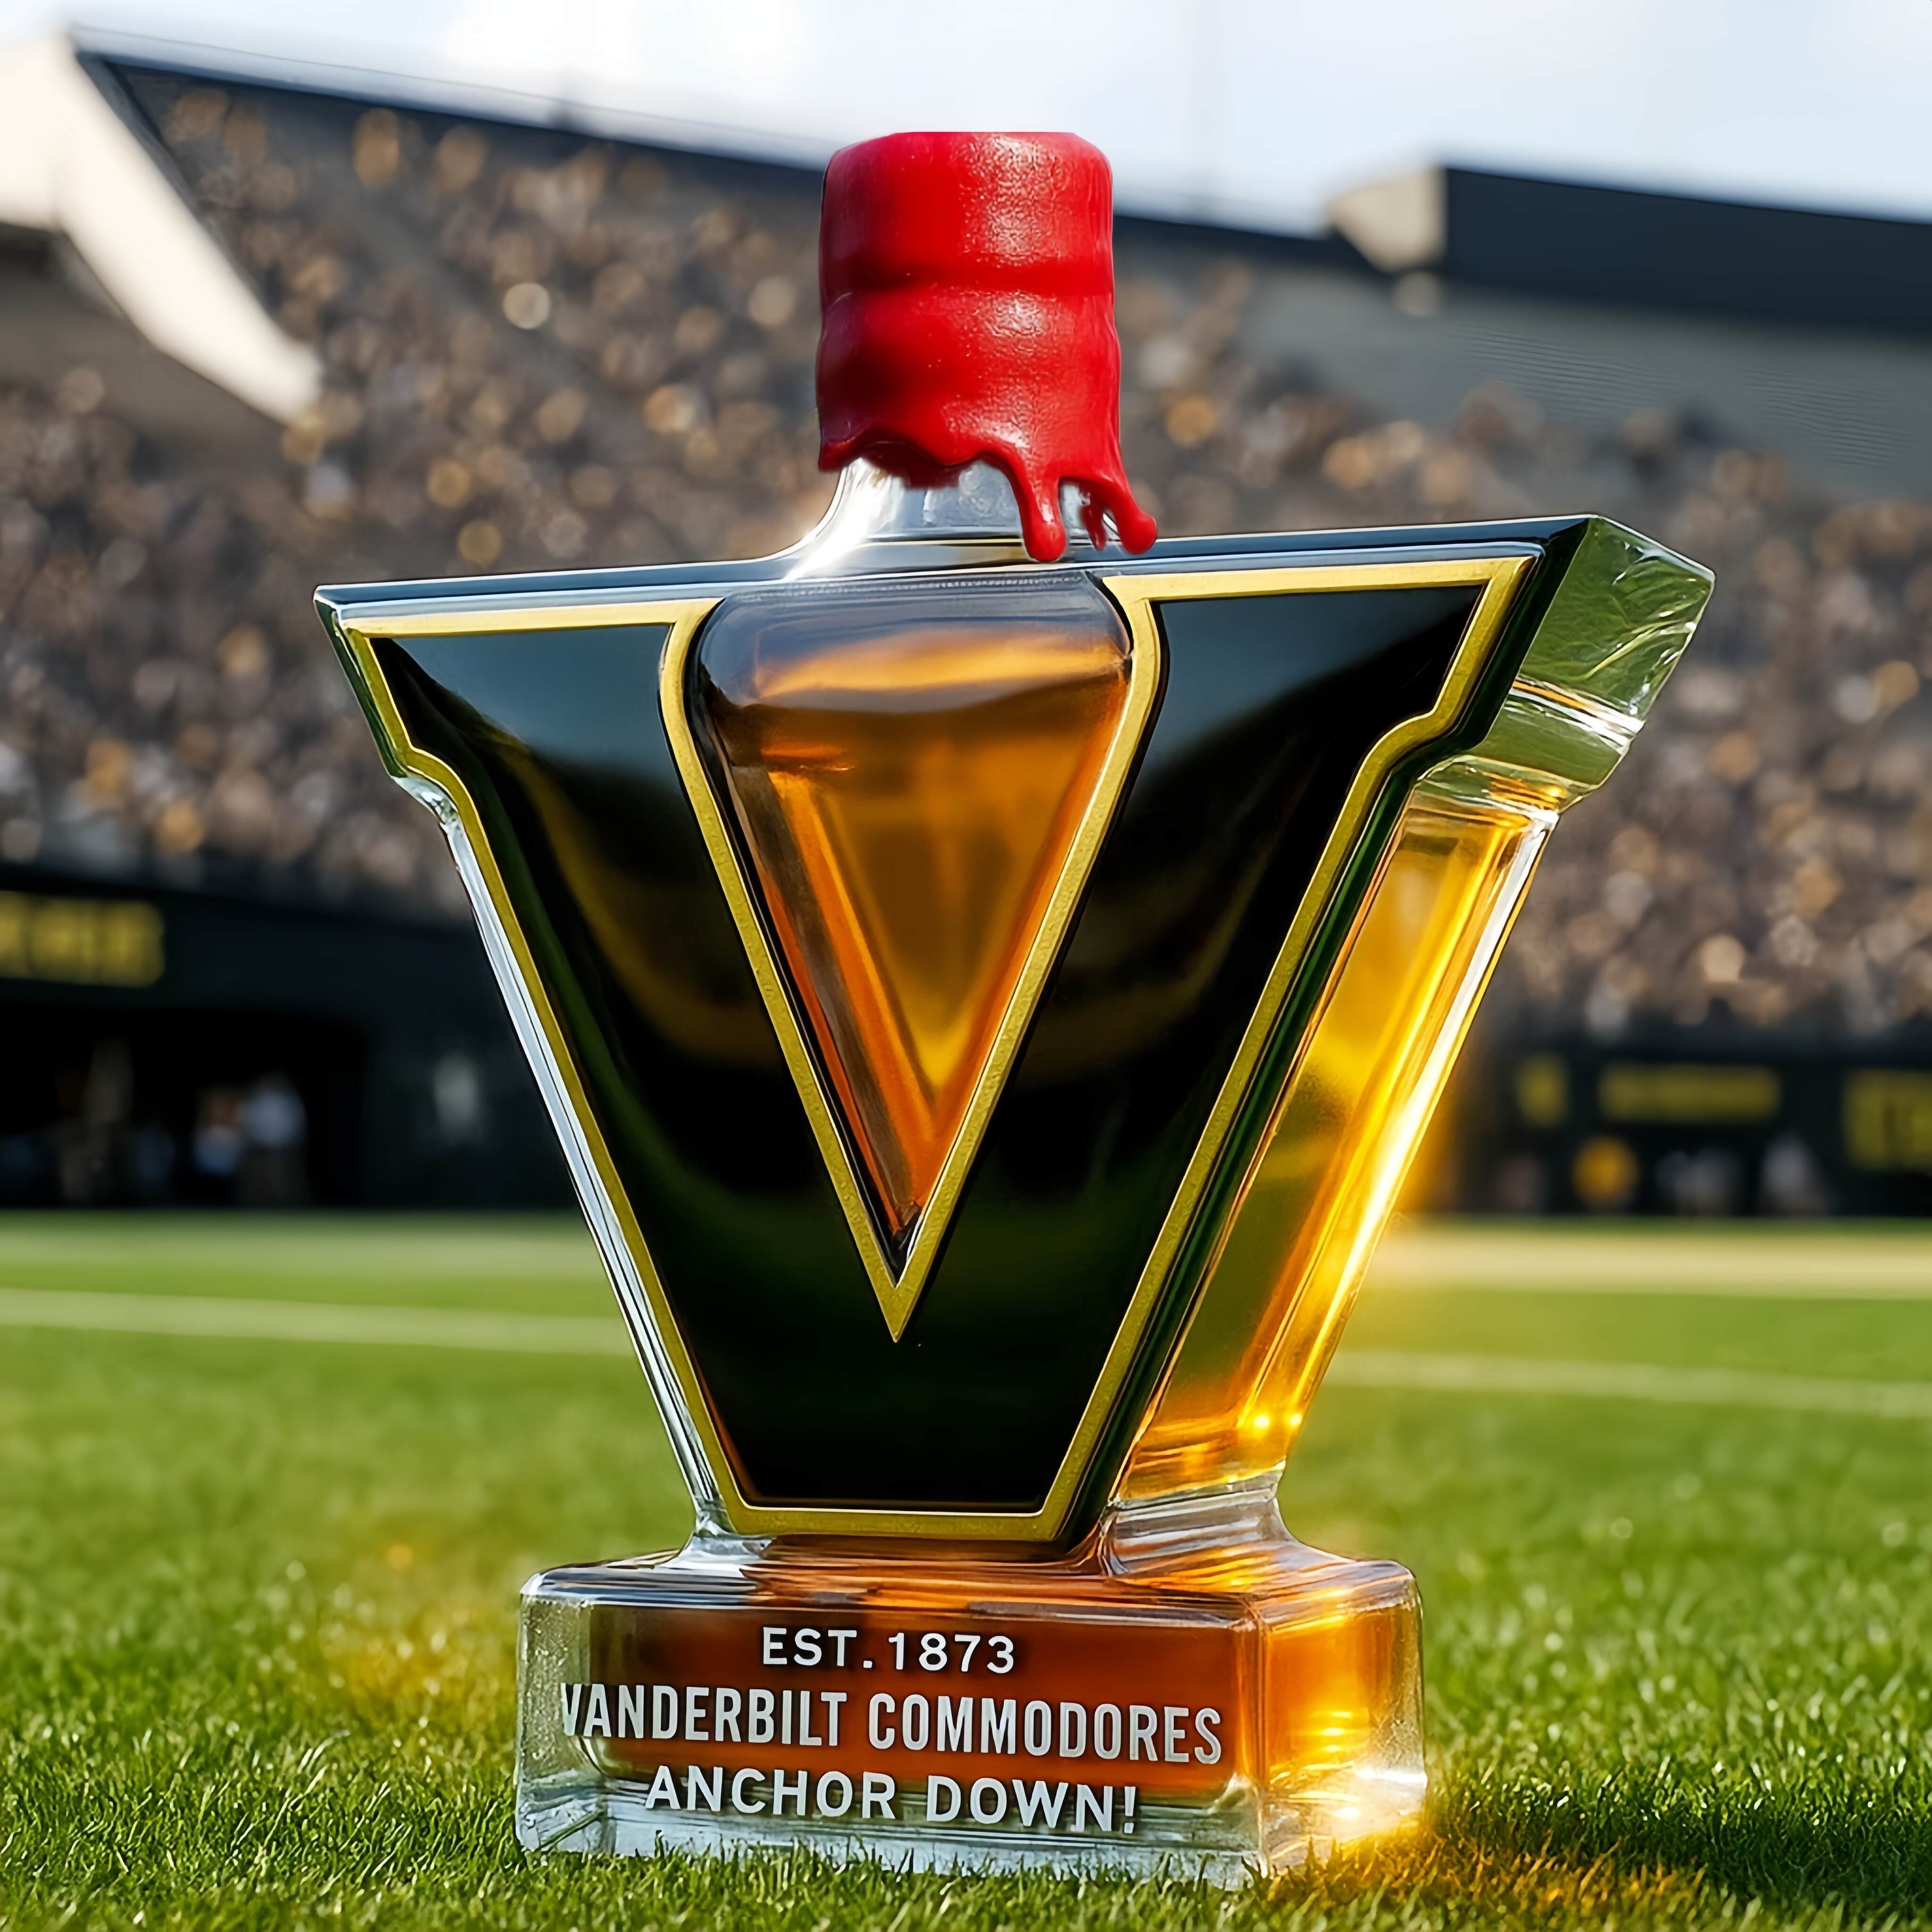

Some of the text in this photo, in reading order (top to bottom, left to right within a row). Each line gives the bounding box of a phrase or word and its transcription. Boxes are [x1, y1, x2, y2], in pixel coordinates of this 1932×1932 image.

[560, 1682, 1222, 1765] VANDERBILT COMMODORES
[644, 1765, 1136, 1834] ANCHOR DOWN!
